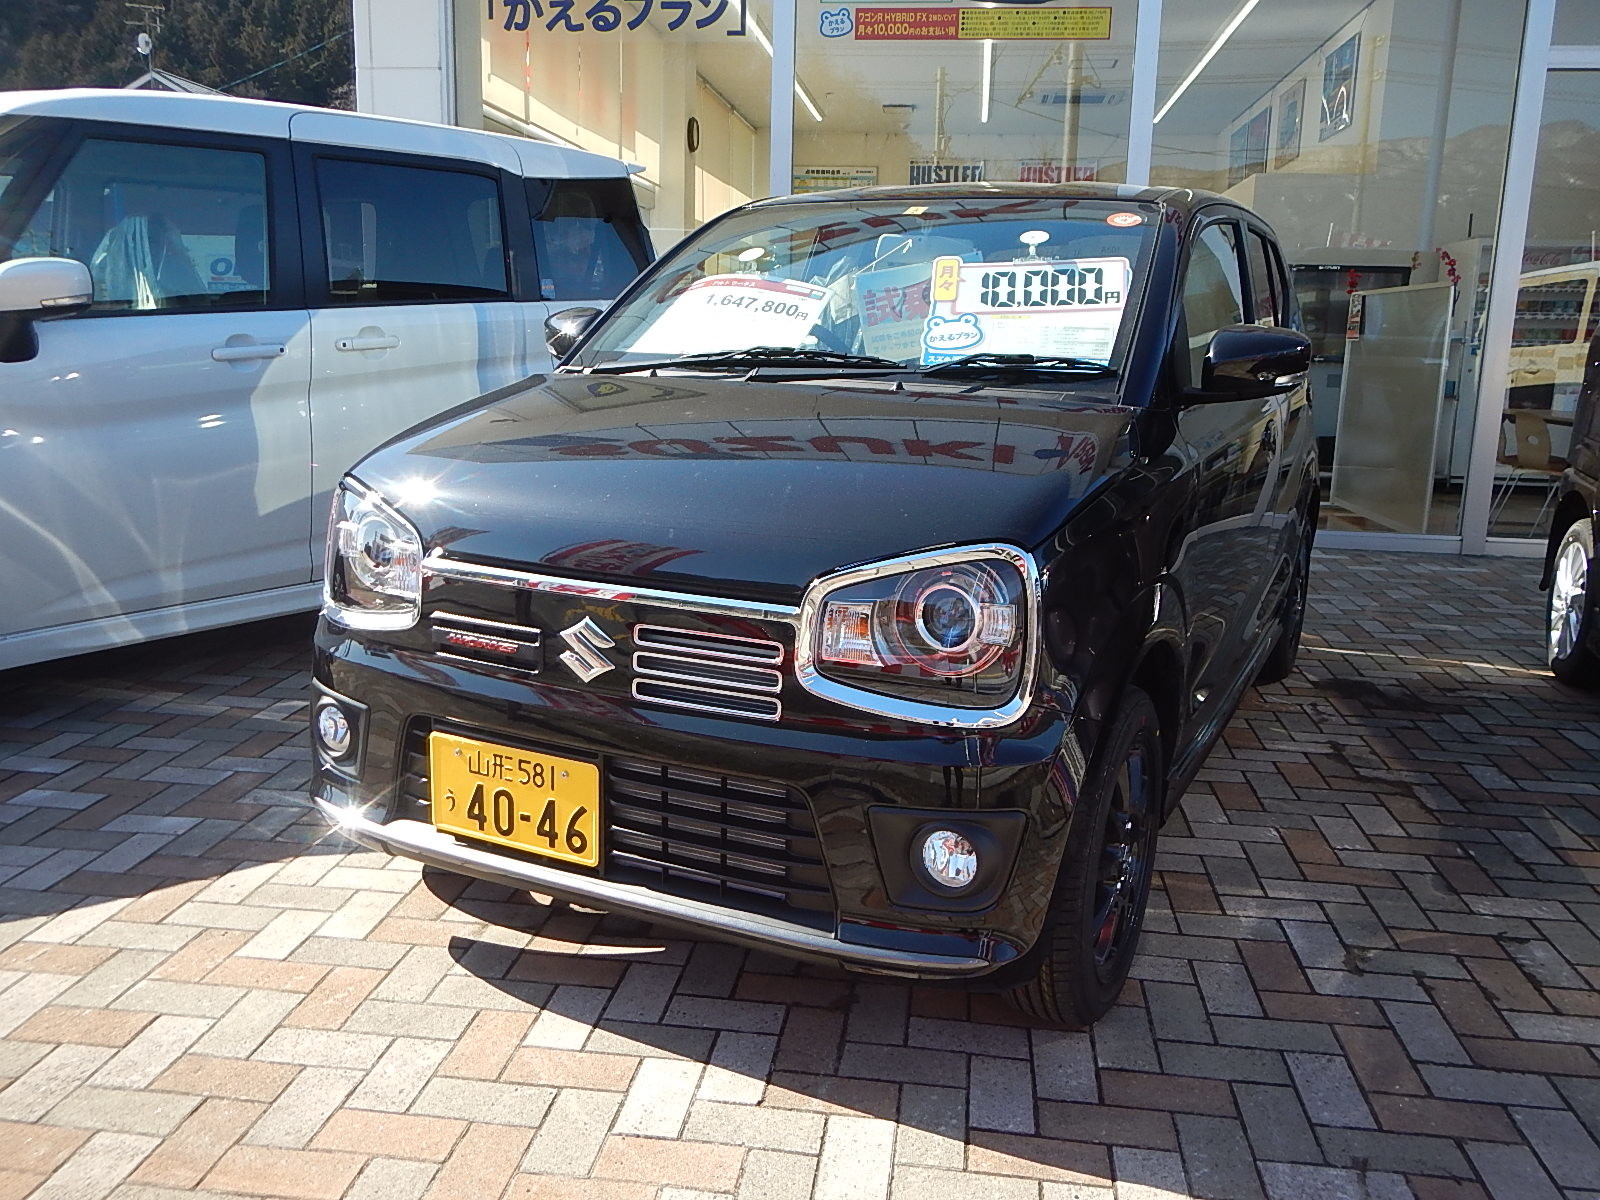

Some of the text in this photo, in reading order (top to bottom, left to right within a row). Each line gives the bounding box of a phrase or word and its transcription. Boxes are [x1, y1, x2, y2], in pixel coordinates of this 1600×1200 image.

[858, 12, 883, 22] ワゴンR
[884, 12, 915, 22] HYBRID
[916, 12, 928, 22] FX
[938, 265, 955, 291] 月々
[929, 331, 978, 343] かえるプラン
[467, 748, 556, 791] 山形581
[443, 783, 589, 854] う 40-46
